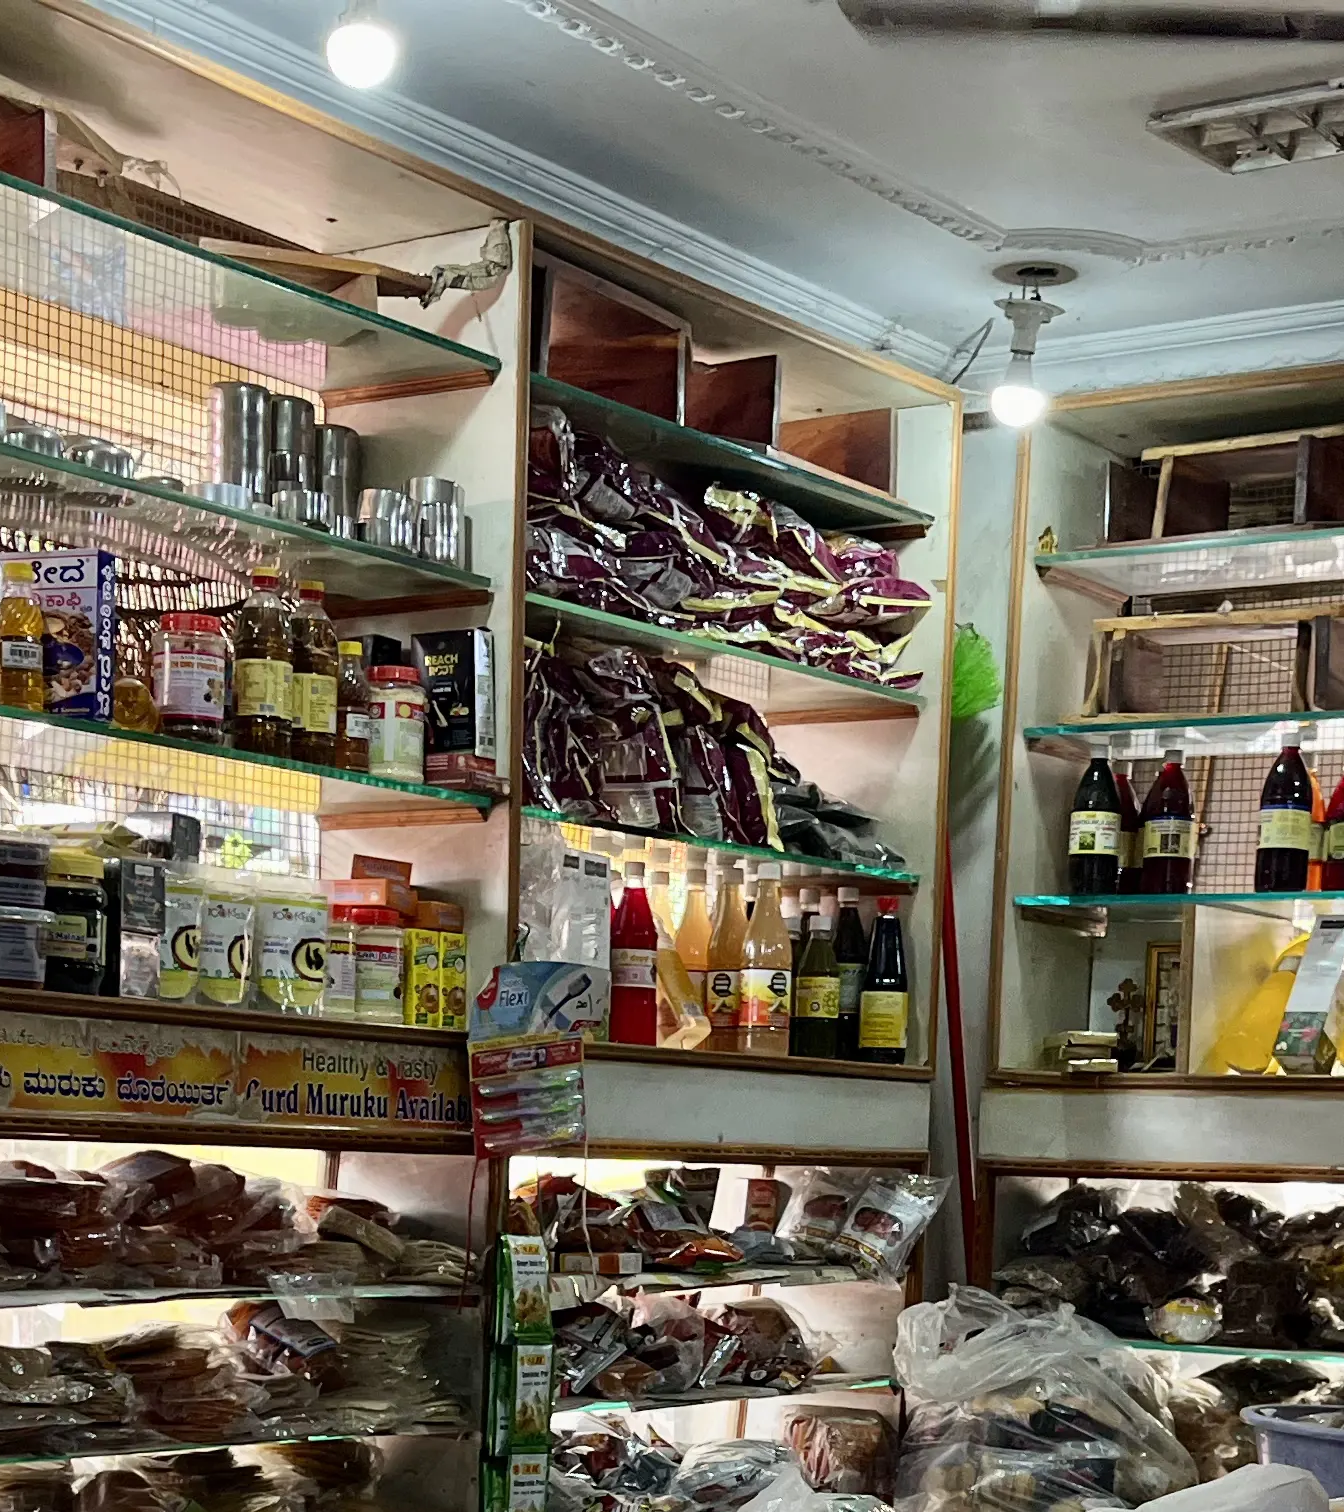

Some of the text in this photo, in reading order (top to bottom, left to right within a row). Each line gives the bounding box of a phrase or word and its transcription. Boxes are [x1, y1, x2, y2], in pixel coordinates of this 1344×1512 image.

[499, 990, 529, 1008] Flexi
[306, 1083, 388, 1118] Muruku
[395, 1089, 472, 1122] Availab
